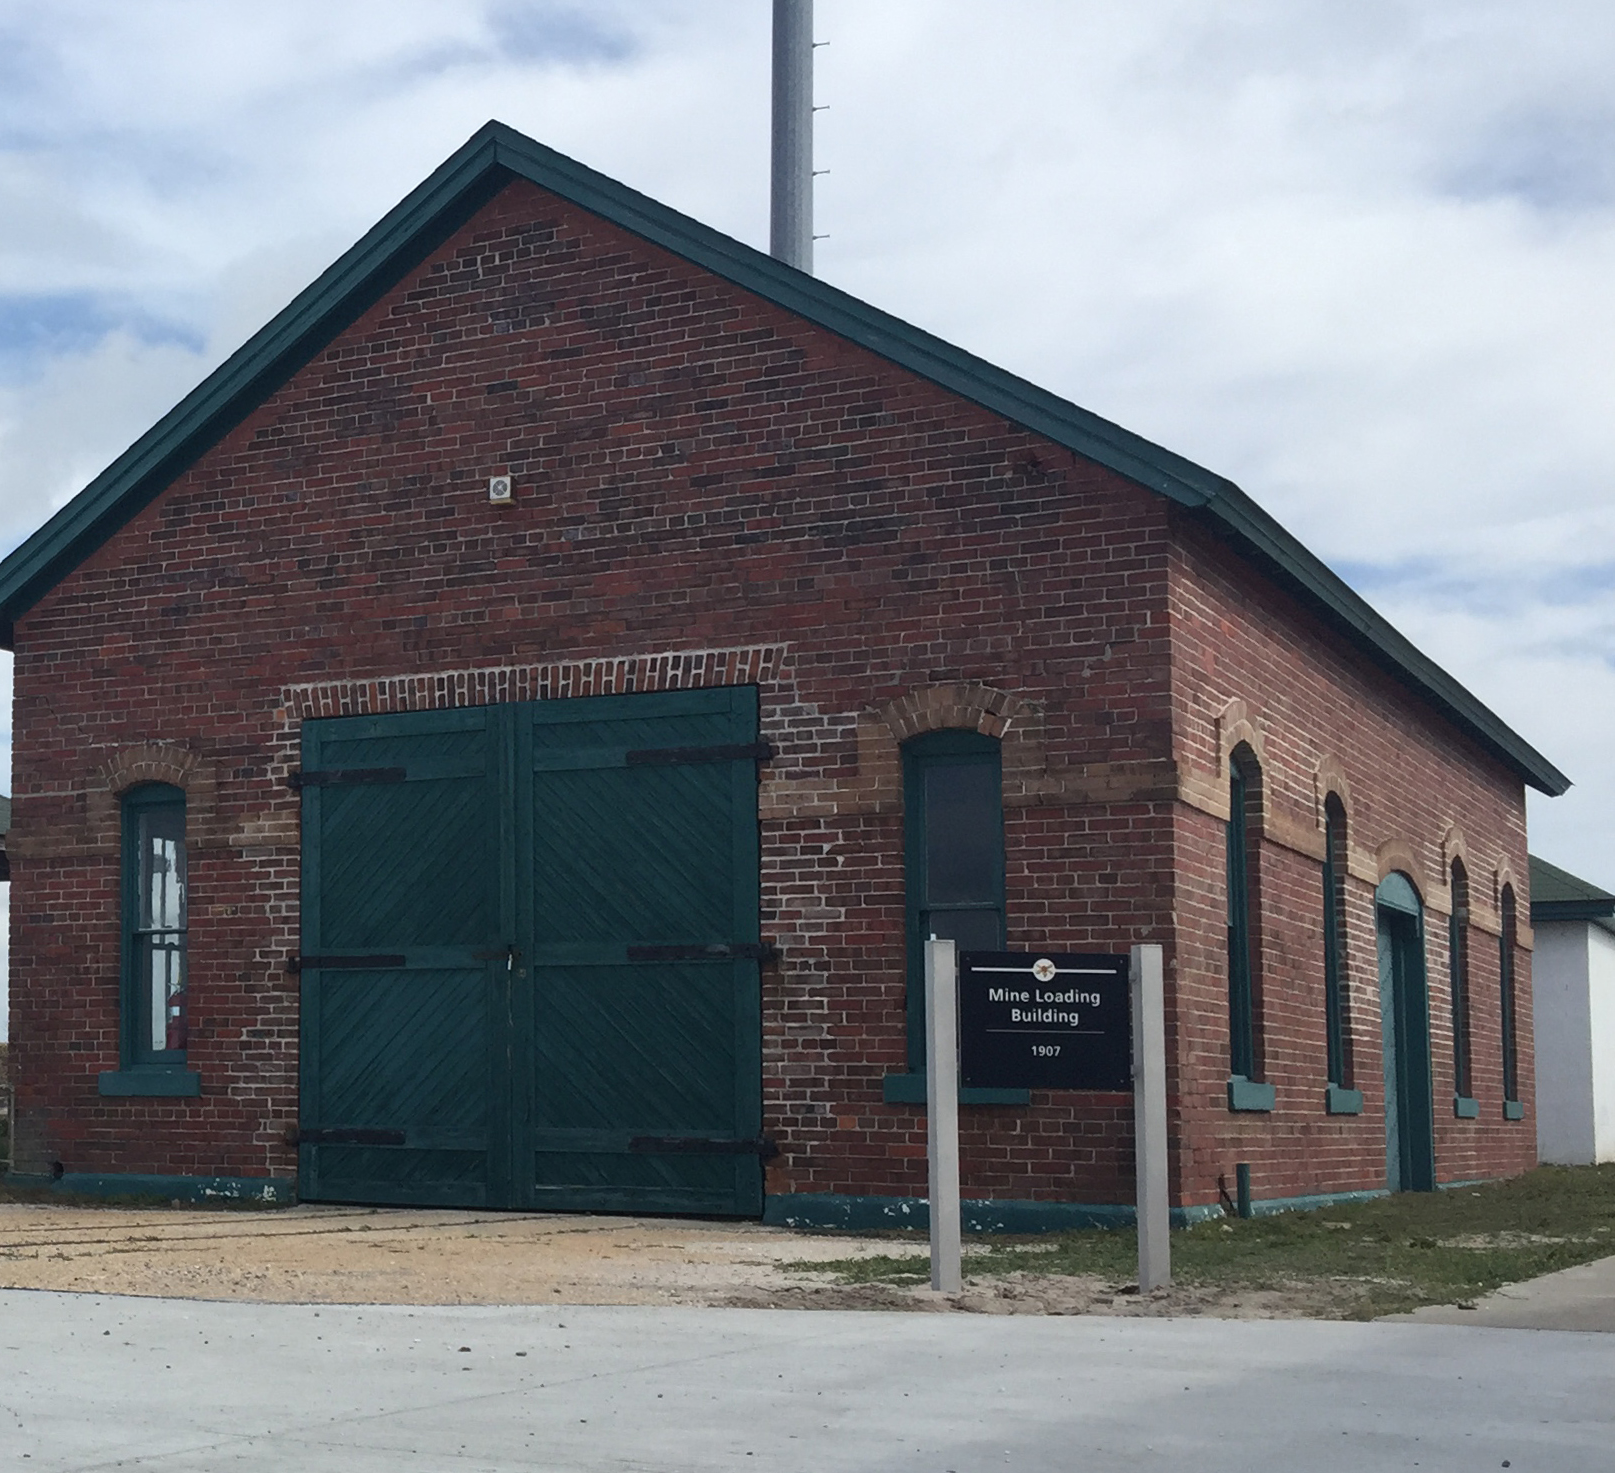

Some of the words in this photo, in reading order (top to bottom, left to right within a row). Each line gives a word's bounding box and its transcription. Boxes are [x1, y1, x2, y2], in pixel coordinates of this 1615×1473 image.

[988, 988, 1030, 1002] Mine
[1035, 989, 1101, 1006] Loading
[1011, 1009, 1079, 1026] Building
[1031, 1046, 1061, 1057] 1907
